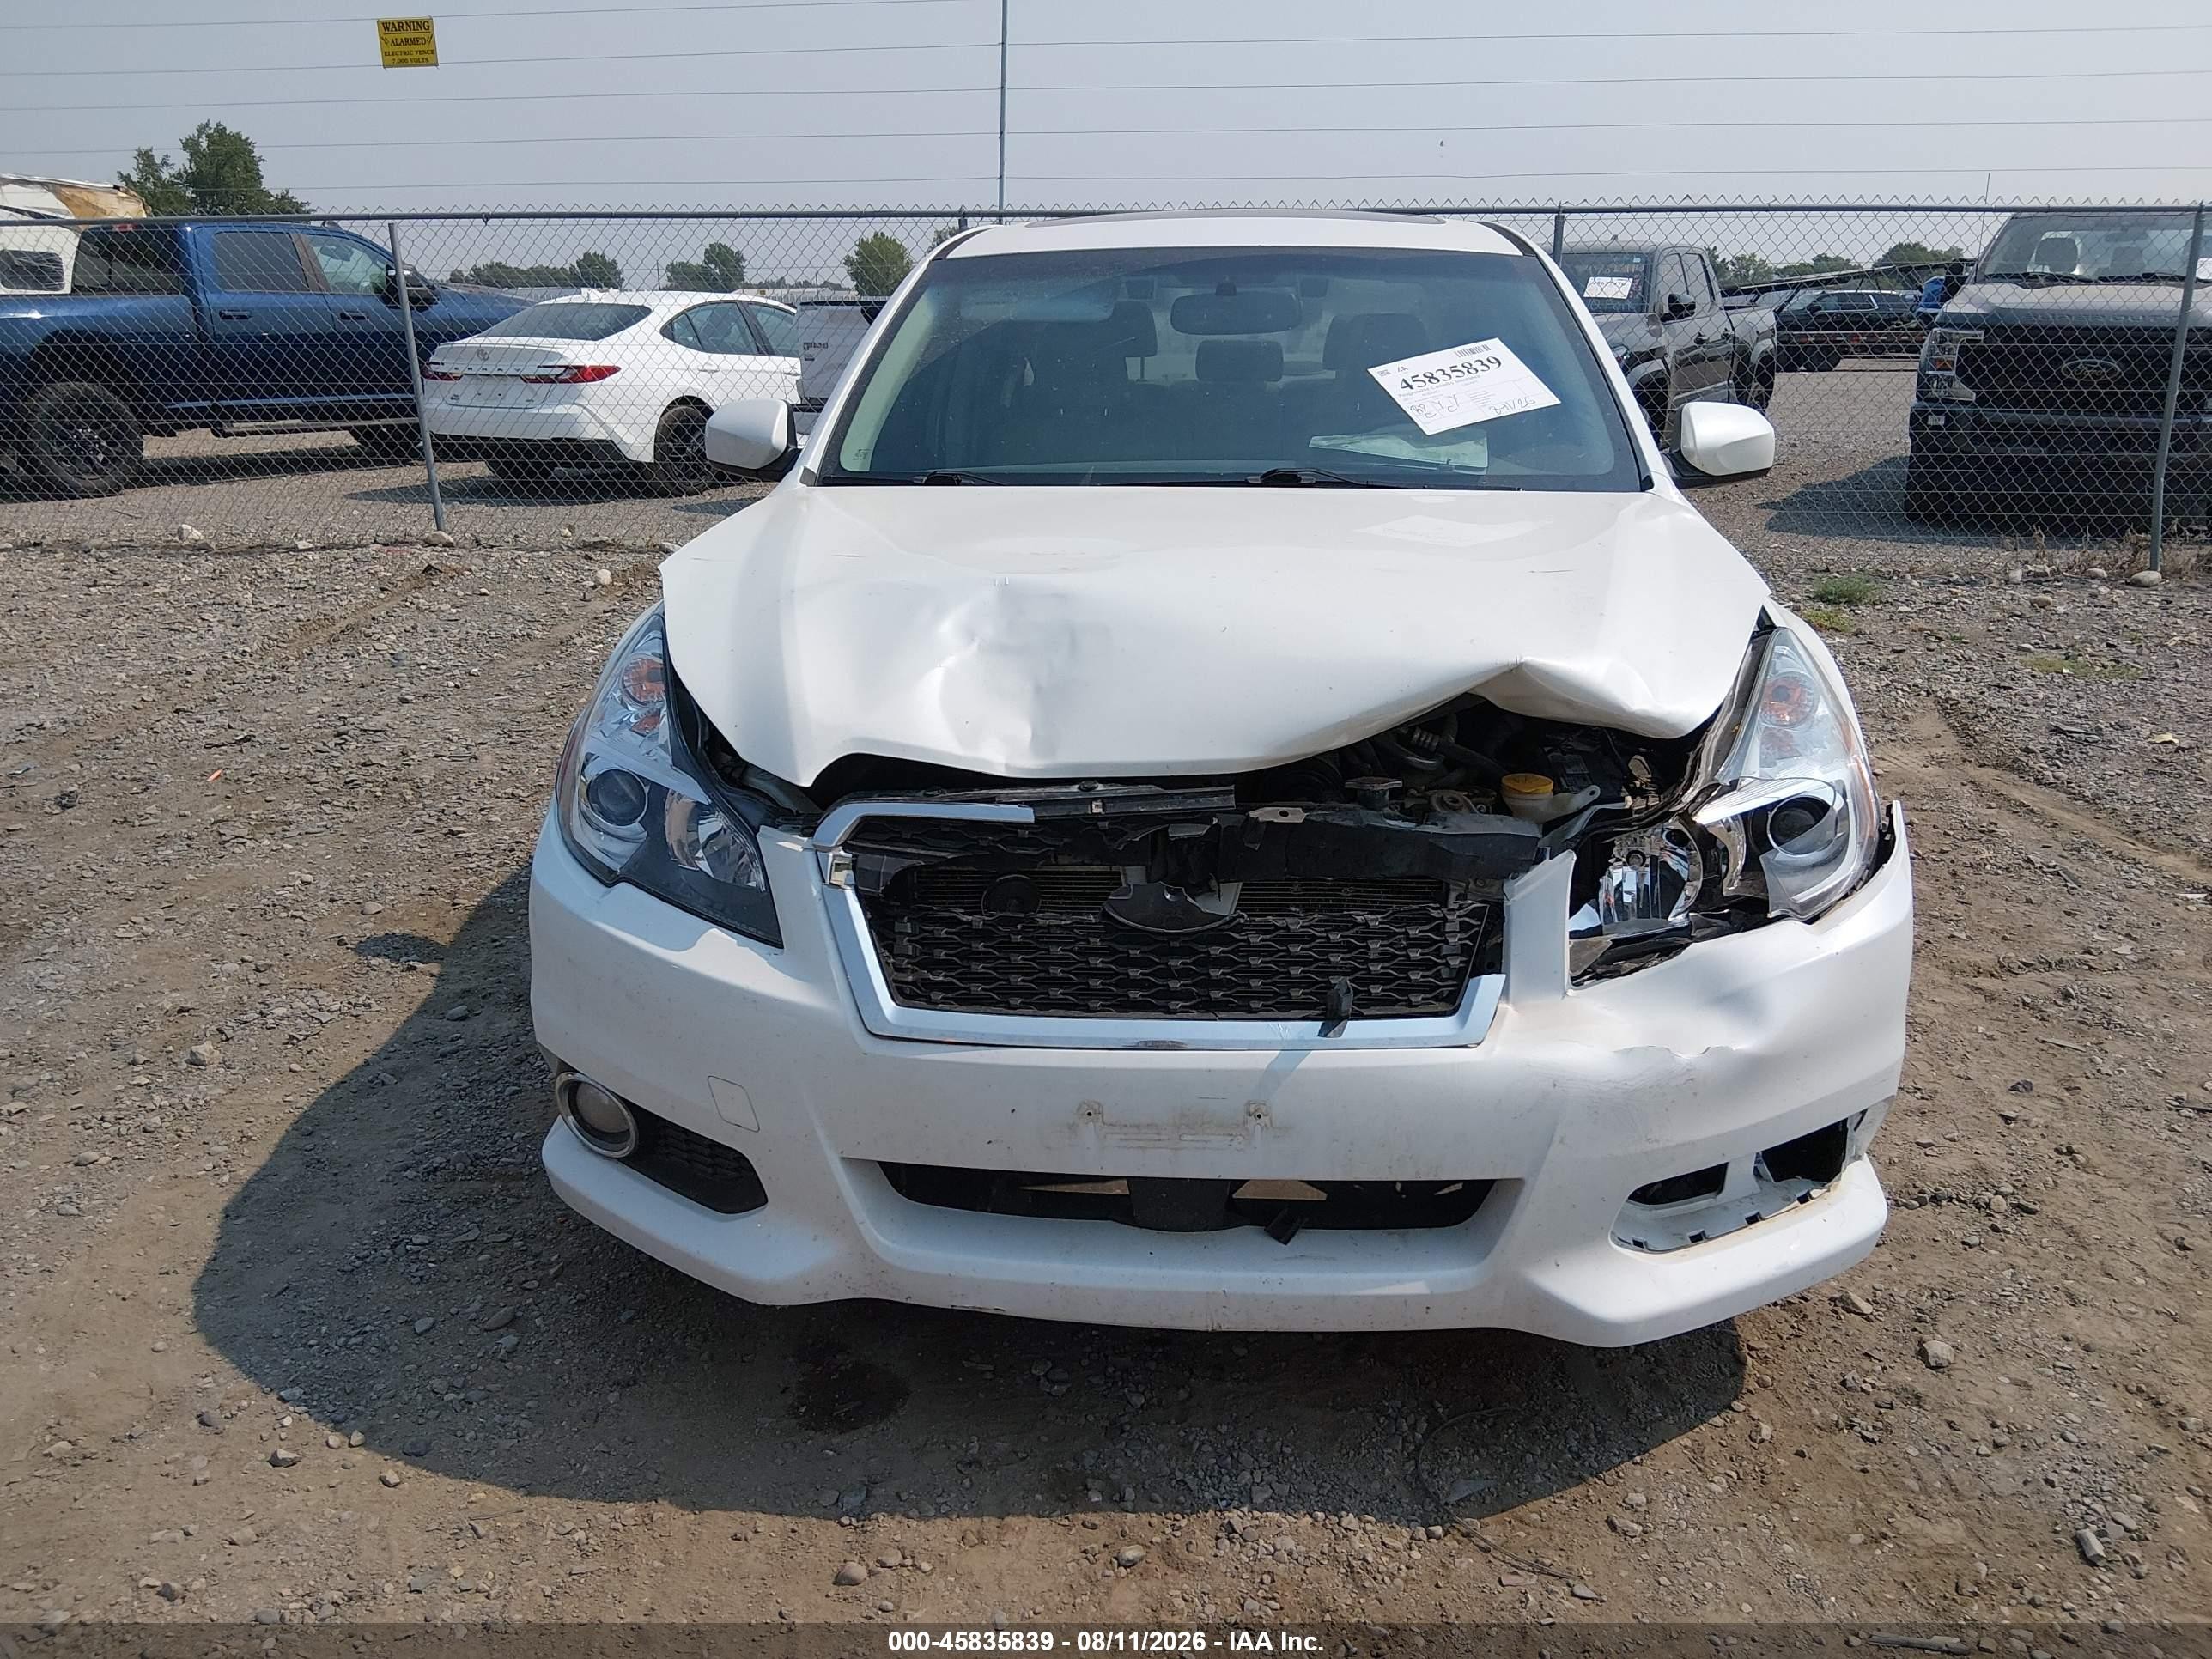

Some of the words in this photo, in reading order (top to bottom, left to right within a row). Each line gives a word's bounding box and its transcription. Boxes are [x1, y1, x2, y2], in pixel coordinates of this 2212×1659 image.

[382, 21, 430, 32] WARNING
[391, 37, 427, 46] ALARMED
[1400, 356, 1502, 391] 45835839
